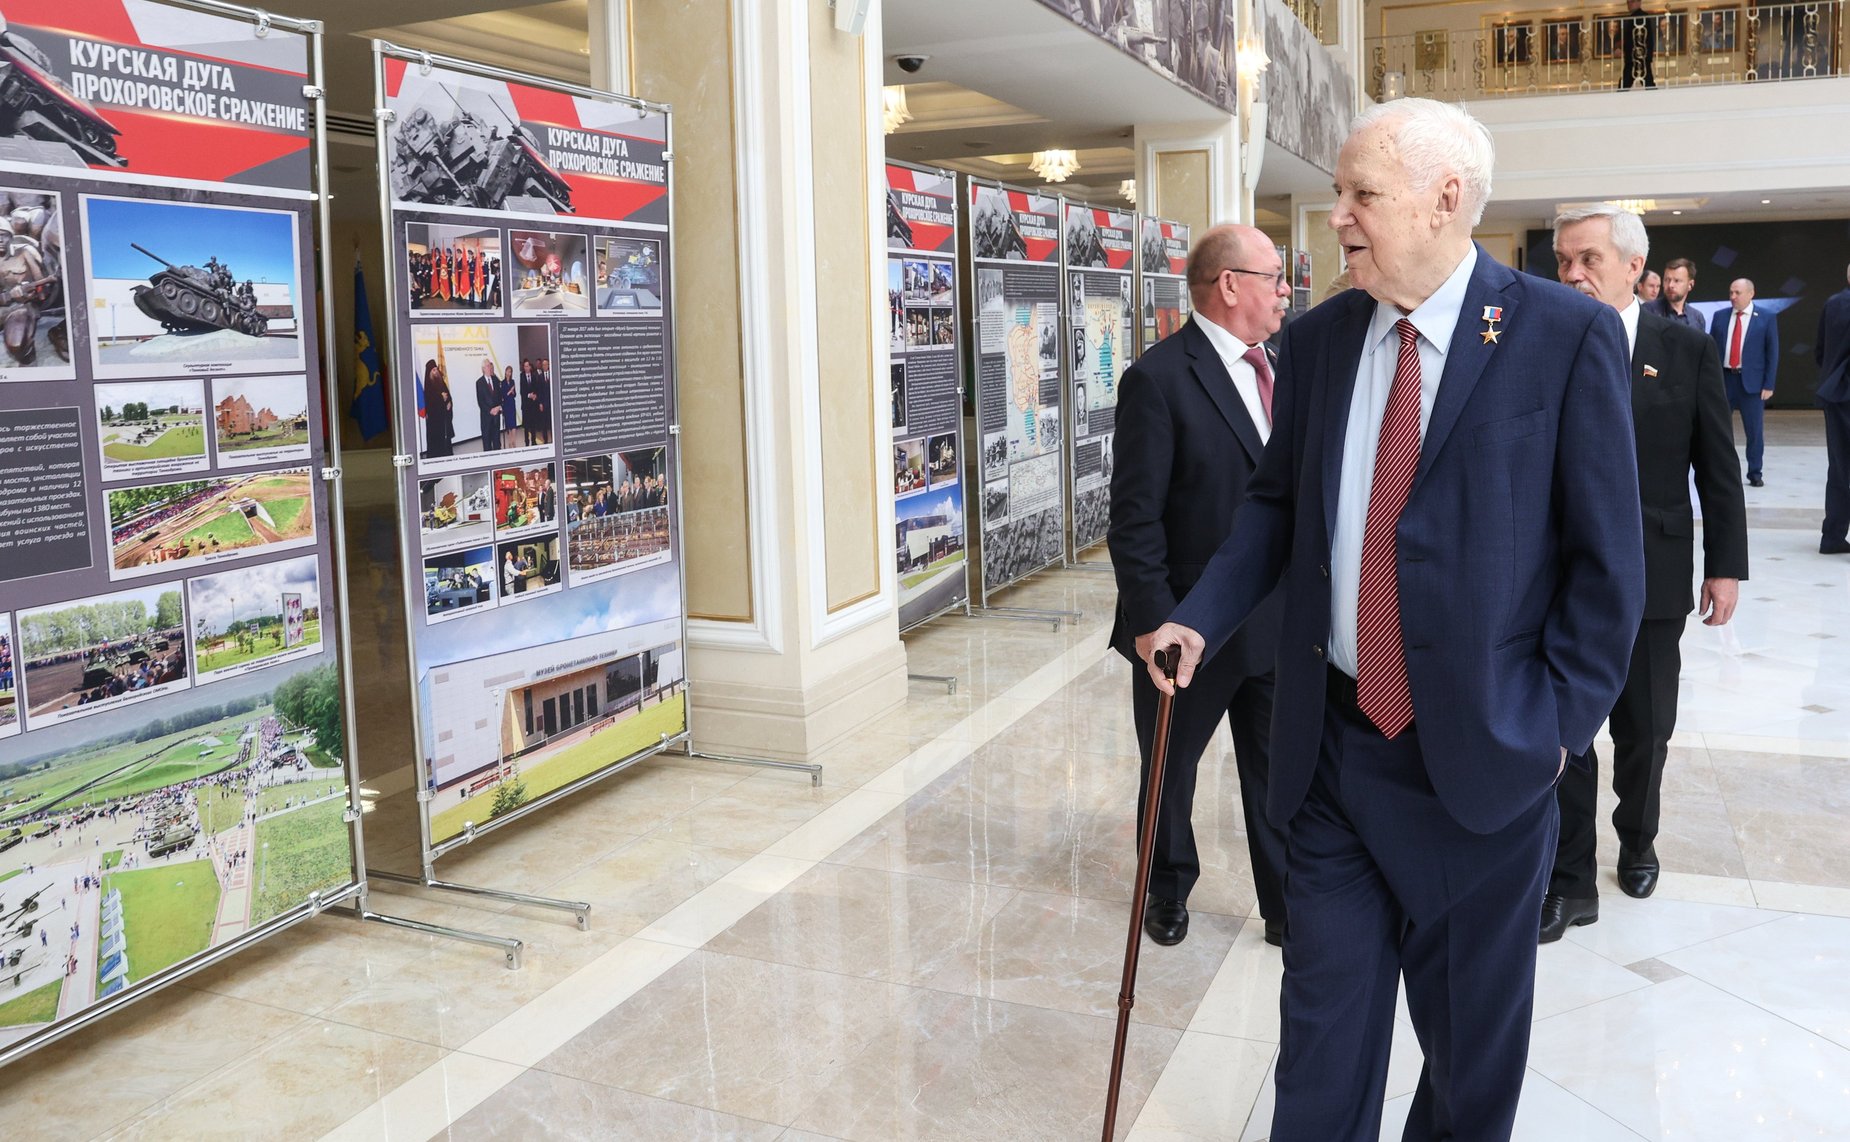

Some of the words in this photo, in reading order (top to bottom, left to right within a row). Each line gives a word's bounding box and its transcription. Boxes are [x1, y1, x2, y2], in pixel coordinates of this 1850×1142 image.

[69, 38, 178, 83] КУРСКАЯ
[182, 60, 236, 92] ДУГА
[70, 71, 217, 119] ПРОХОРОВСКОЕ
[219, 97, 306, 132] СРАЖЕНИЕ
[547, 127, 600, 153] КУРСКАЯ
[601, 135, 629, 158] ДУГА
[548, 149, 620, 174] ПРОХОРОВСКОЕ
[620, 162, 665, 183] СРАЖЕНИЕ
[14, 422, 77, 432] торжественное
[25, 433, 47, 441] собой
[48, 432, 78, 440] участок
[26, 441, 79, 452] искусственно
[48, 461, 80, 470] которая
[3, 476, 32, 485] моста,
[33, 472, 81, 481] инсталляции
[39, 483, 70, 491] наличии
[73, 480, 82, 488] 12
[48, 491, 82, 501] проездах.
[33, 504, 50, 513] 1380
[27, 511, 85, 523] использованием
[14, 525, 51, 536] воинских
[54, 520, 85, 530] частей,
[17, 537, 41, 547] услуга
[44, 532, 74, 543] проезда
[536, 664, 556, 676] МУЗЕЙ
